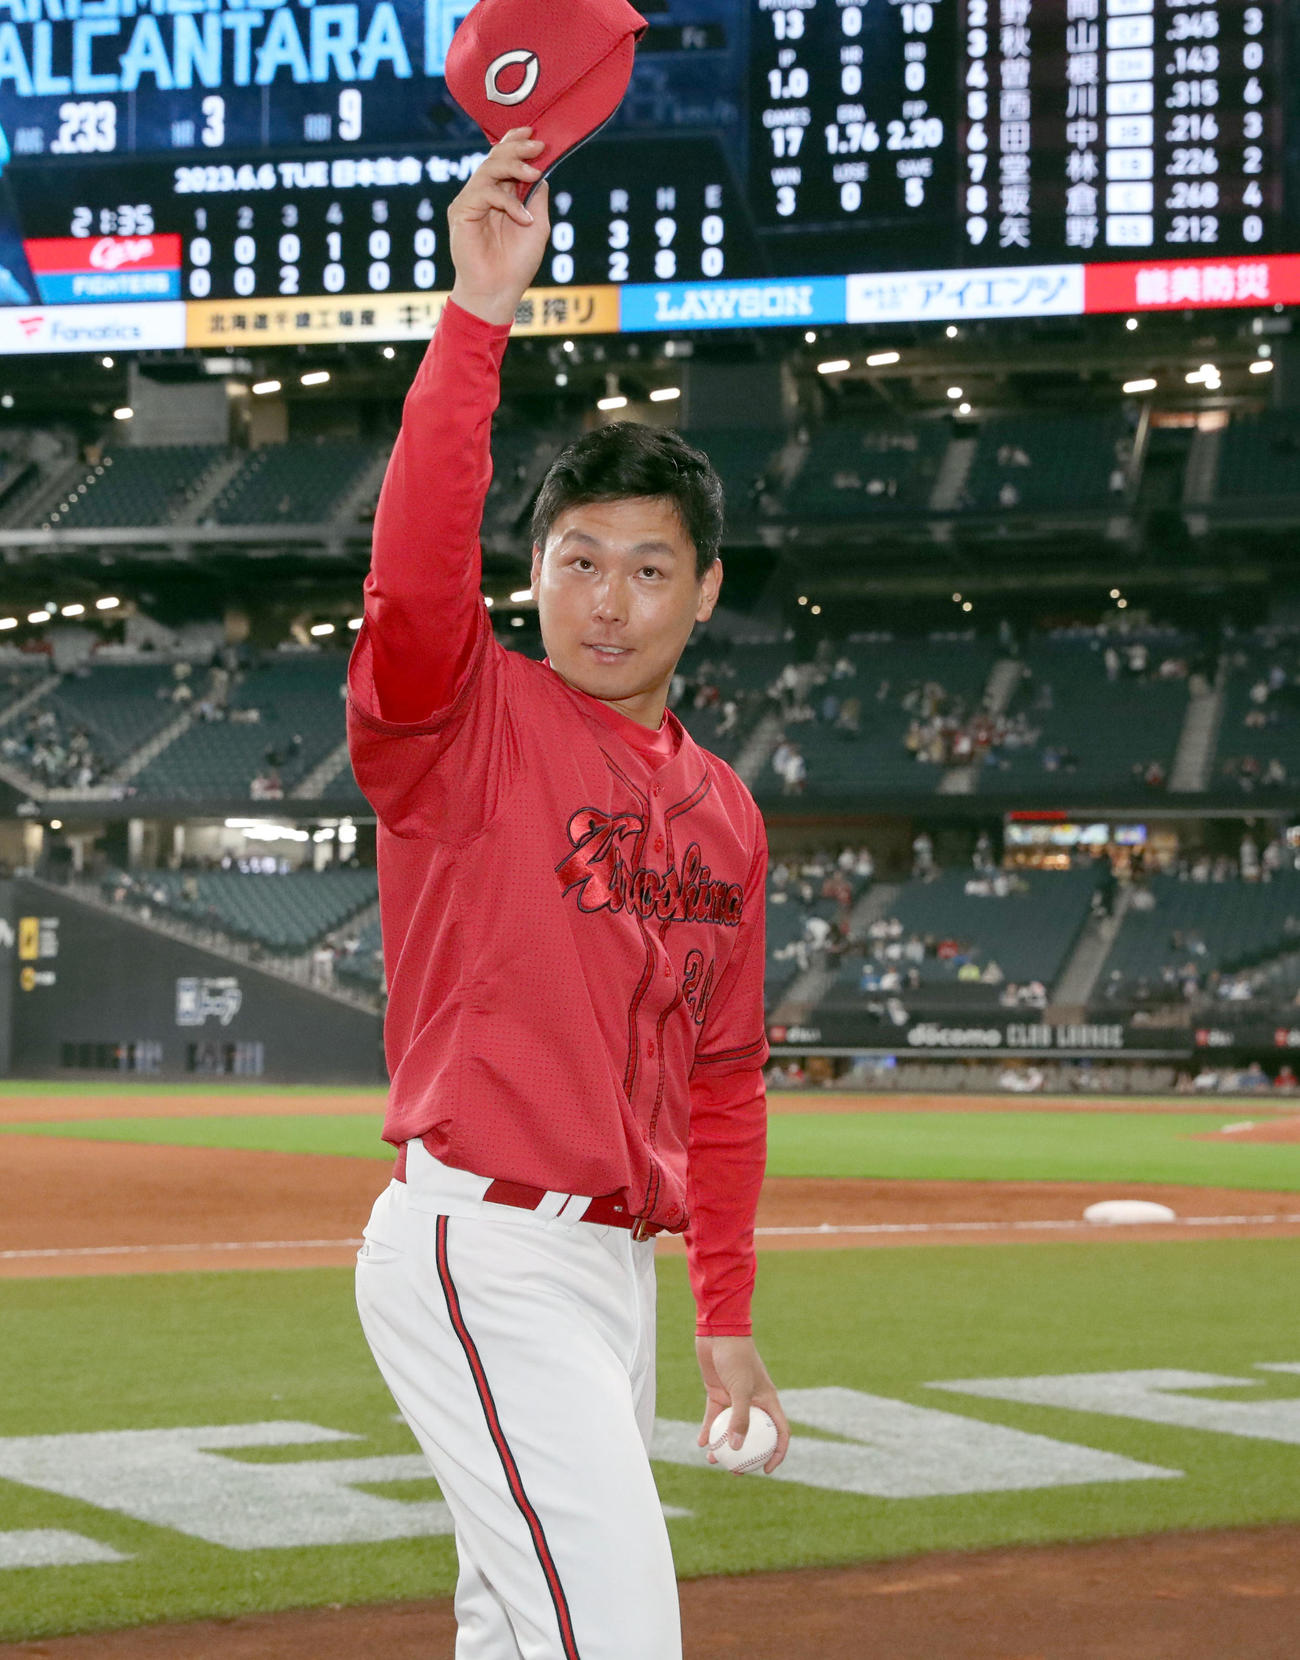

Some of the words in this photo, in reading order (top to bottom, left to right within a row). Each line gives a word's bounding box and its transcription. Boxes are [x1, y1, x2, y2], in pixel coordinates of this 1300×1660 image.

[773, 9, 804, 40] 13
[842, 6, 862, 36] 0
[901, 3, 932, 33] 10
[968, 0, 987, 26] 2
[968, 29, 987, 57] 3
[1166, 11, 1219, 40] .345
[1244, 8, 1263, 34] 3
[0, 3, 412, 96] ALCANTARA
[967, 60, 988, 88] 4
[1166, 45, 1219, 74] .143
[1243, 43, 1263, 69] 0
[768, 68, 808, 99] 1.0
[842, 65, 861, 95] 0
[905, 62, 925, 91] 0
[339, 89, 361, 140] 9
[968, 91, 987, 120] 5
[1166, 79, 1218, 107] .315
[1244, 77, 1262, 103] 6
[51, 101, 116, 153] .233
[202, 96, 225, 147] 3
[825, 121, 879, 154] 1.76
[887, 118, 943, 150] 2.20
[967, 123, 988, 151] 6
[1166, 114, 1218, 141] .216
[1244, 112, 1262, 138] 3
[772, 127, 803, 157] 17
[278, 161, 328, 188] TUE
[968, 154, 987, 182] 7
[1166, 148, 1218, 175] .226
[1243, 146, 1262, 173] 2
[195, 209, 206, 230] 1
[238, 207, 253, 229] 2
[283, 205, 298, 227] 3
[327, 203, 343, 224] 4
[373, 201, 388, 223] 5
[418, 199, 433, 221] 6
[555, 193, 571, 214] 9
[611, 190, 628, 212] R
[657, 188, 675, 210] H
[706, 185, 720, 208] E
[777, 186, 795, 216] 3
[841, 182, 861, 211] 0
[905, 177, 924, 207] 5
[967, 185, 987, 213] 8
[1166, 182, 1218, 208] .268
[1243, 181, 1262, 207] 4
[190, 238, 211, 266] 0
[235, 236, 255, 264] 0
[279, 234, 300, 263] 0
[327, 232, 341, 261] 1
[369, 230, 390, 259] 0
[414, 228, 435, 257] 0
[553, 222, 574, 251] 0
[609, 220, 629, 249] 3
[655, 218, 676, 247] 9
[702, 215, 723, 245] 0
[967, 216, 987, 244] 9
[1166, 216, 1218, 242] .212
[1243, 215, 1262, 242] 0
[190, 269, 210, 297] 0
[234, 267, 255, 295] 0
[280, 265, 299, 294] 2
[324, 263, 344, 292] 0
[369, 262, 390, 290] 0
[414, 260, 435, 288] 0
[552, 254, 573, 283] 0
[609, 252, 628, 281] 2
[655, 250, 676, 278] 8
[702, 247, 723, 277] 0
[1135, 263, 1269, 304] 能美防災
[654, 287, 813, 321] LAWSON
[52, 321, 142, 341] Fanatics
[908, 1023, 1001, 1046] docomo
